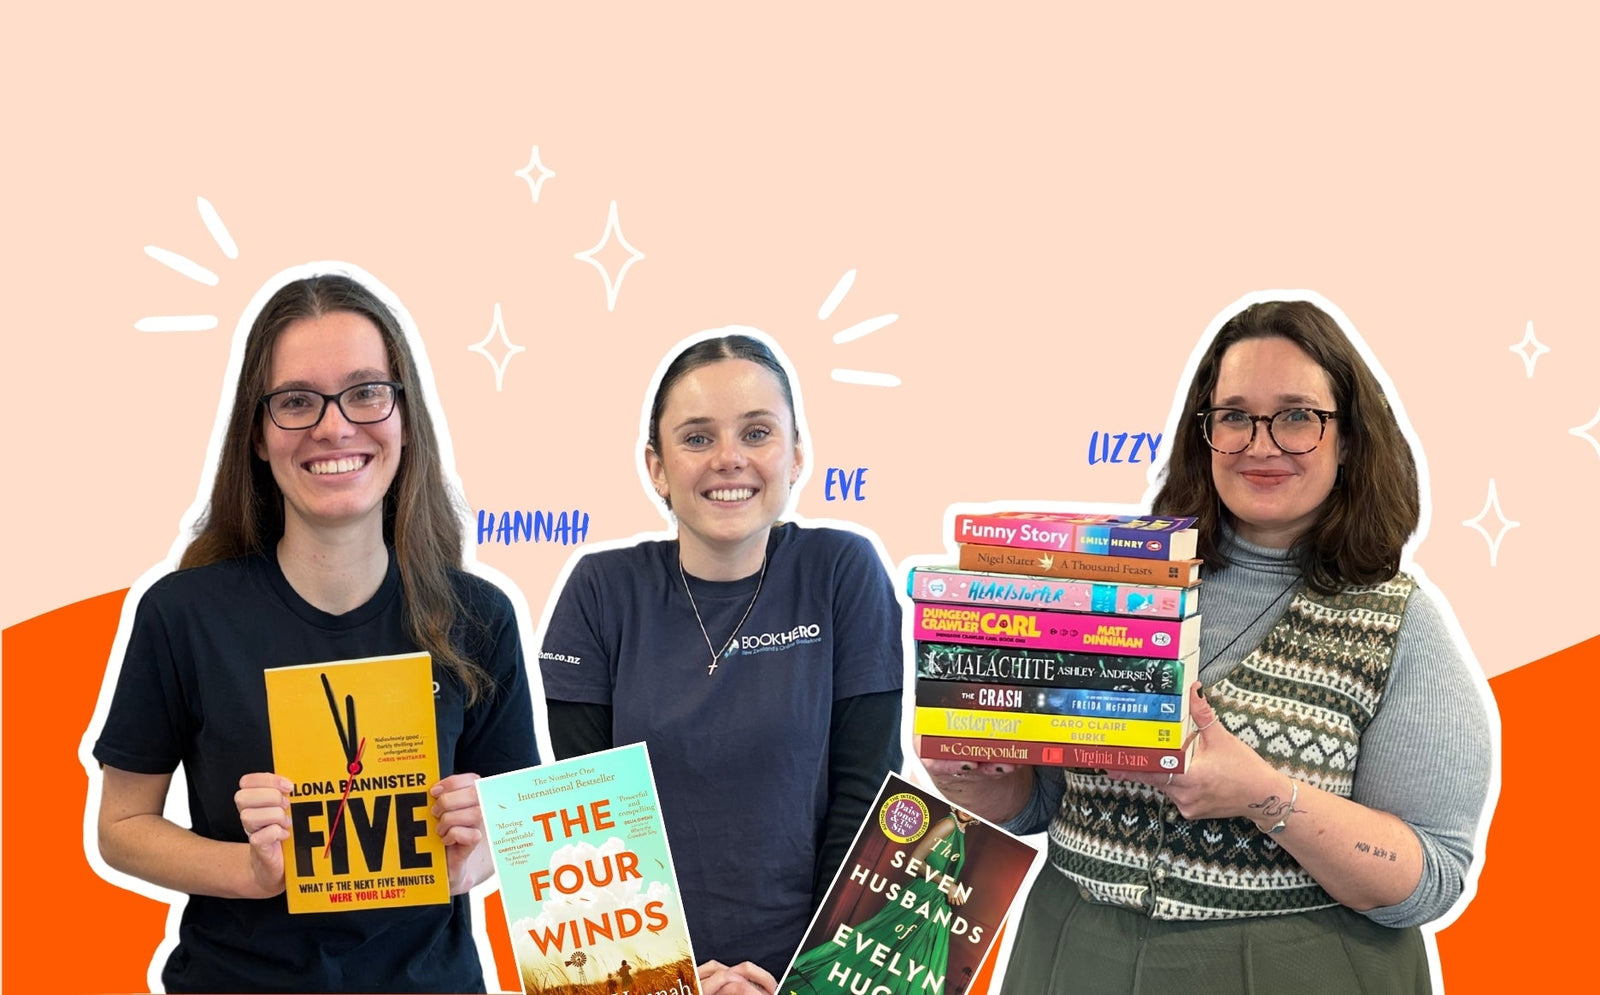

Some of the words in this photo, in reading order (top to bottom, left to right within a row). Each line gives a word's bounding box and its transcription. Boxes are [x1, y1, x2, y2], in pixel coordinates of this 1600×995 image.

[962, 519, 1017, 544] Funny
[1020, 524, 1069, 549] Story
[1080, 536, 1109, 546] EMILY
[1111, 538, 1143, 549] HENRY
[978, 553, 1004, 566] Nigel
[1007, 555, 1035, 566] Slater
[1061, 561, 1068, 569] A
[1071, 561, 1120, 574] Thousand
[1123, 566, 1152, 576] Feasts
[923, 608, 980, 622] DUNGEON
[921, 618, 979, 633] CRAWLER
[980, 612, 1042, 638] CARL
[1097, 625, 1128, 637] MATT
[1083, 634, 1143, 648] DINNIMAN
[947, 653, 1055, 681] MALACHITE
[1057, 666, 1095, 677] ASHLEY
[1100, 669, 1153, 682] ANDERSEN
[962, 692, 975, 700] THE
[978, 688, 1023, 708] CRASH
[1072, 700, 1101, 711] FREIDA
[1106, 702, 1149, 713] McFADDEN
[945, 711, 1022, 737] Yesteryear
[1051, 719, 1084, 728] CARO
[1088, 721, 1127, 732] CLAIRE
[1070, 732, 1106, 742] BURKE
[940, 744, 951, 753] The
[951, 743, 1028, 760] Correspondent
[1074, 748, 1113, 766] Virginia
[1118, 751, 1149, 767] Evans
[339, 773, 426, 793] BANNISTER
[548, 771, 578, 782] Number
[579, 767, 595, 776] One
[518, 782, 574, 802] International
[575, 774, 616, 789] Bestseller
[628, 799, 640, 807] and
[896, 800, 921, 818] Daisy
[531, 799, 616, 843] THE
[891, 823, 906, 836] Six
[900, 819, 914, 830] The
[290, 791, 432, 877] FIVE
[505, 827, 518, 835] and
[930, 837, 960, 863] The
[299, 883, 323, 894] WHAT
[326, 882, 334, 892] IF
[336, 881, 351, 891] THE
[354, 879, 375, 890] NEXT
[378, 877, 395, 888] FIVE
[397, 874, 435, 886] MINUTES
[529, 851, 643, 902] FOUR
[890, 850, 973, 903] SEVEN
[330, 893, 353, 903] WERE
[355, 891, 379, 901] YOUR
[381, 888, 406, 899] LAST?
[850, 863, 984, 945] HUSBANDS
[528, 901, 669, 957] WINDS
[894, 923, 918, 940] of
[832, 922, 947, 995] EVELYN
